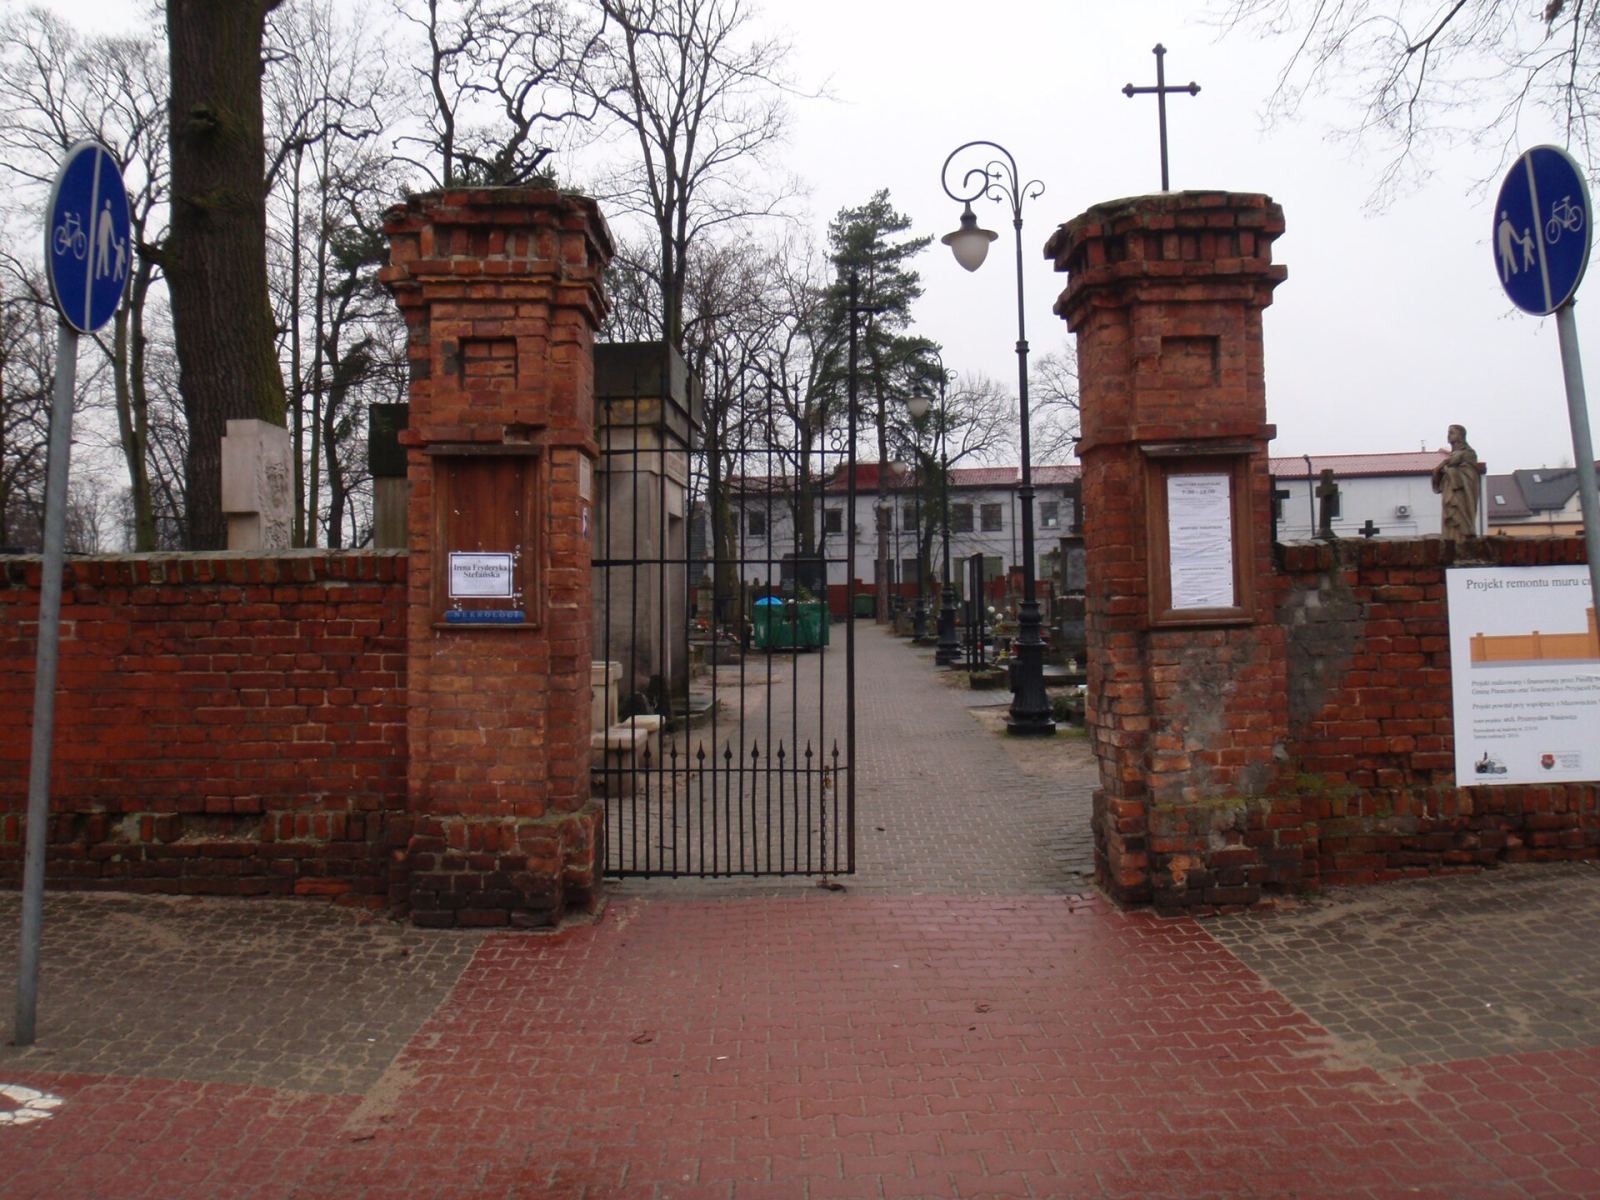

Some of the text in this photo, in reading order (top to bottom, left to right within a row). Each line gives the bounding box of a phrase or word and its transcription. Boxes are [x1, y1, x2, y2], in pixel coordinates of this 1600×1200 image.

[1466, 579, 1503, 591] Projekt
[1506, 579, 1549, 588] remontu
[1552, 578, 1579, 586] muru
